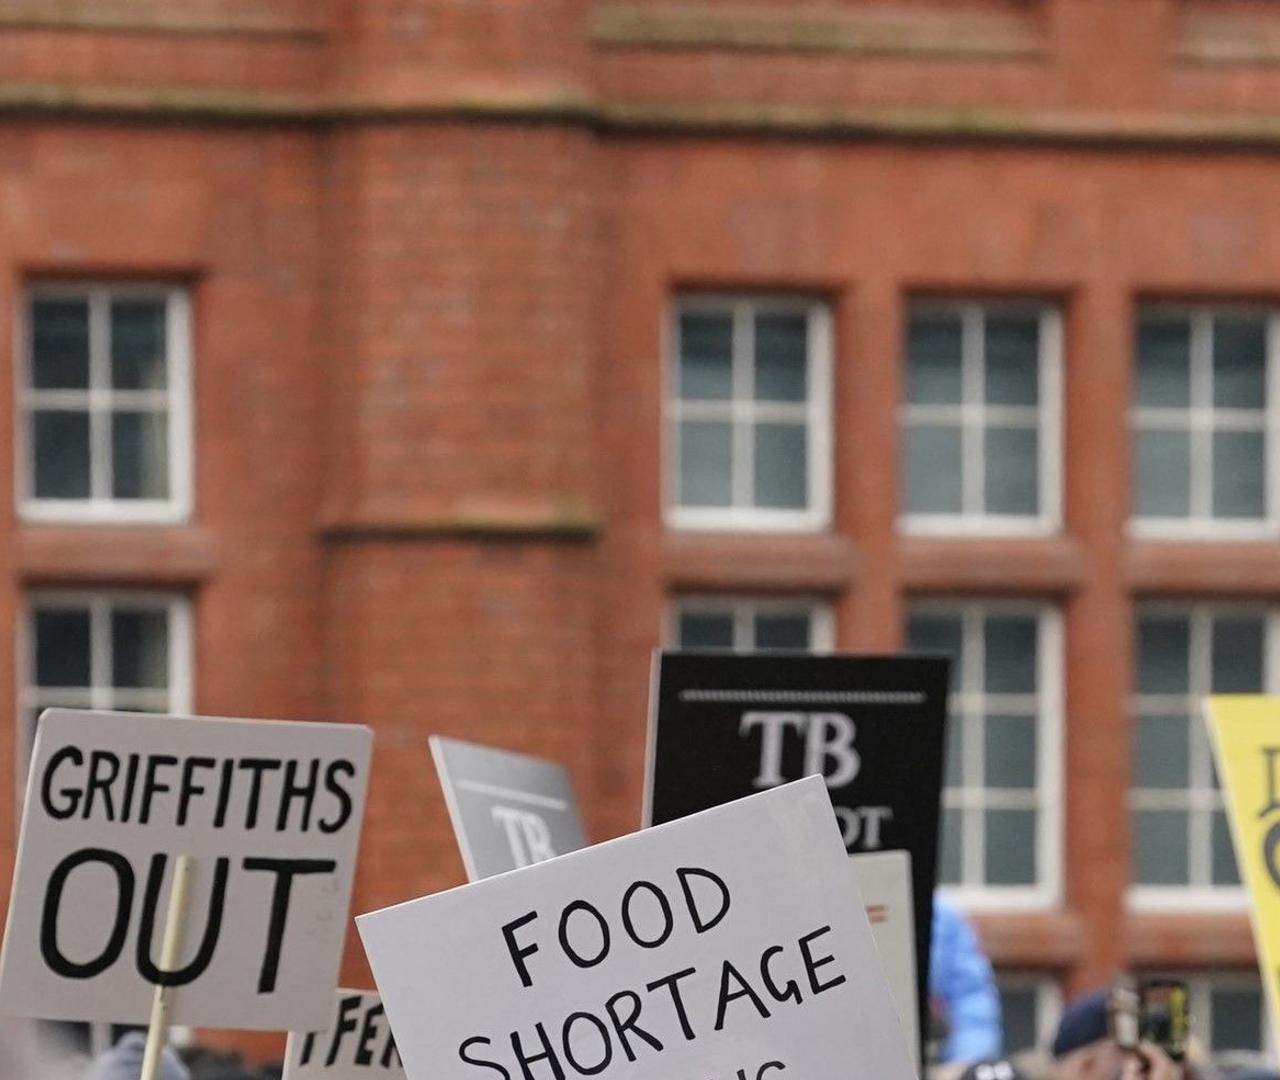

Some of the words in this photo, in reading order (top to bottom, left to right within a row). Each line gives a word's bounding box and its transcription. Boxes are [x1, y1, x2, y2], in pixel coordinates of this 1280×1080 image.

[41, 745, 355, 834] GRIFFITHS
[738, 710, 861, 788] TB
[40, 848, 336, 994] OUT
[501, 866, 731, 988] FOOD
